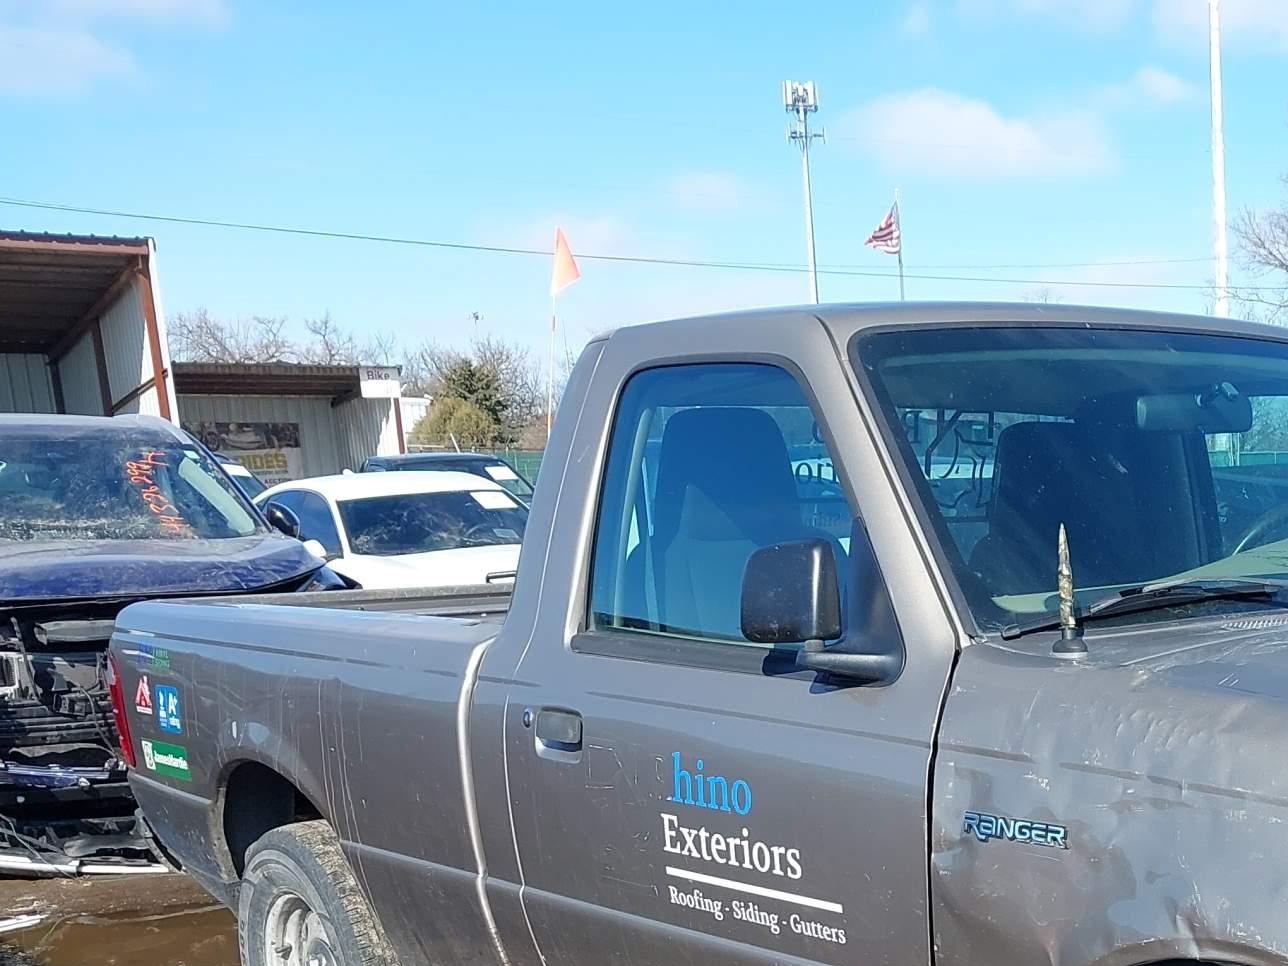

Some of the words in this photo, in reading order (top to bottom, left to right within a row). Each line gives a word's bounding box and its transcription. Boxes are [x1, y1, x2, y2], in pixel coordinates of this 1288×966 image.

[367, 370, 390, 381] Bike
[672, 751, 752, 816] hino
[660, 813, 802, 880] Exteriors
[963, 810, 1069, 850] RANGER
[668, 885, 724, 921] Roofing
[732, 900, 780, 935] Siding
[789, 914, 847, 945] Gutters
